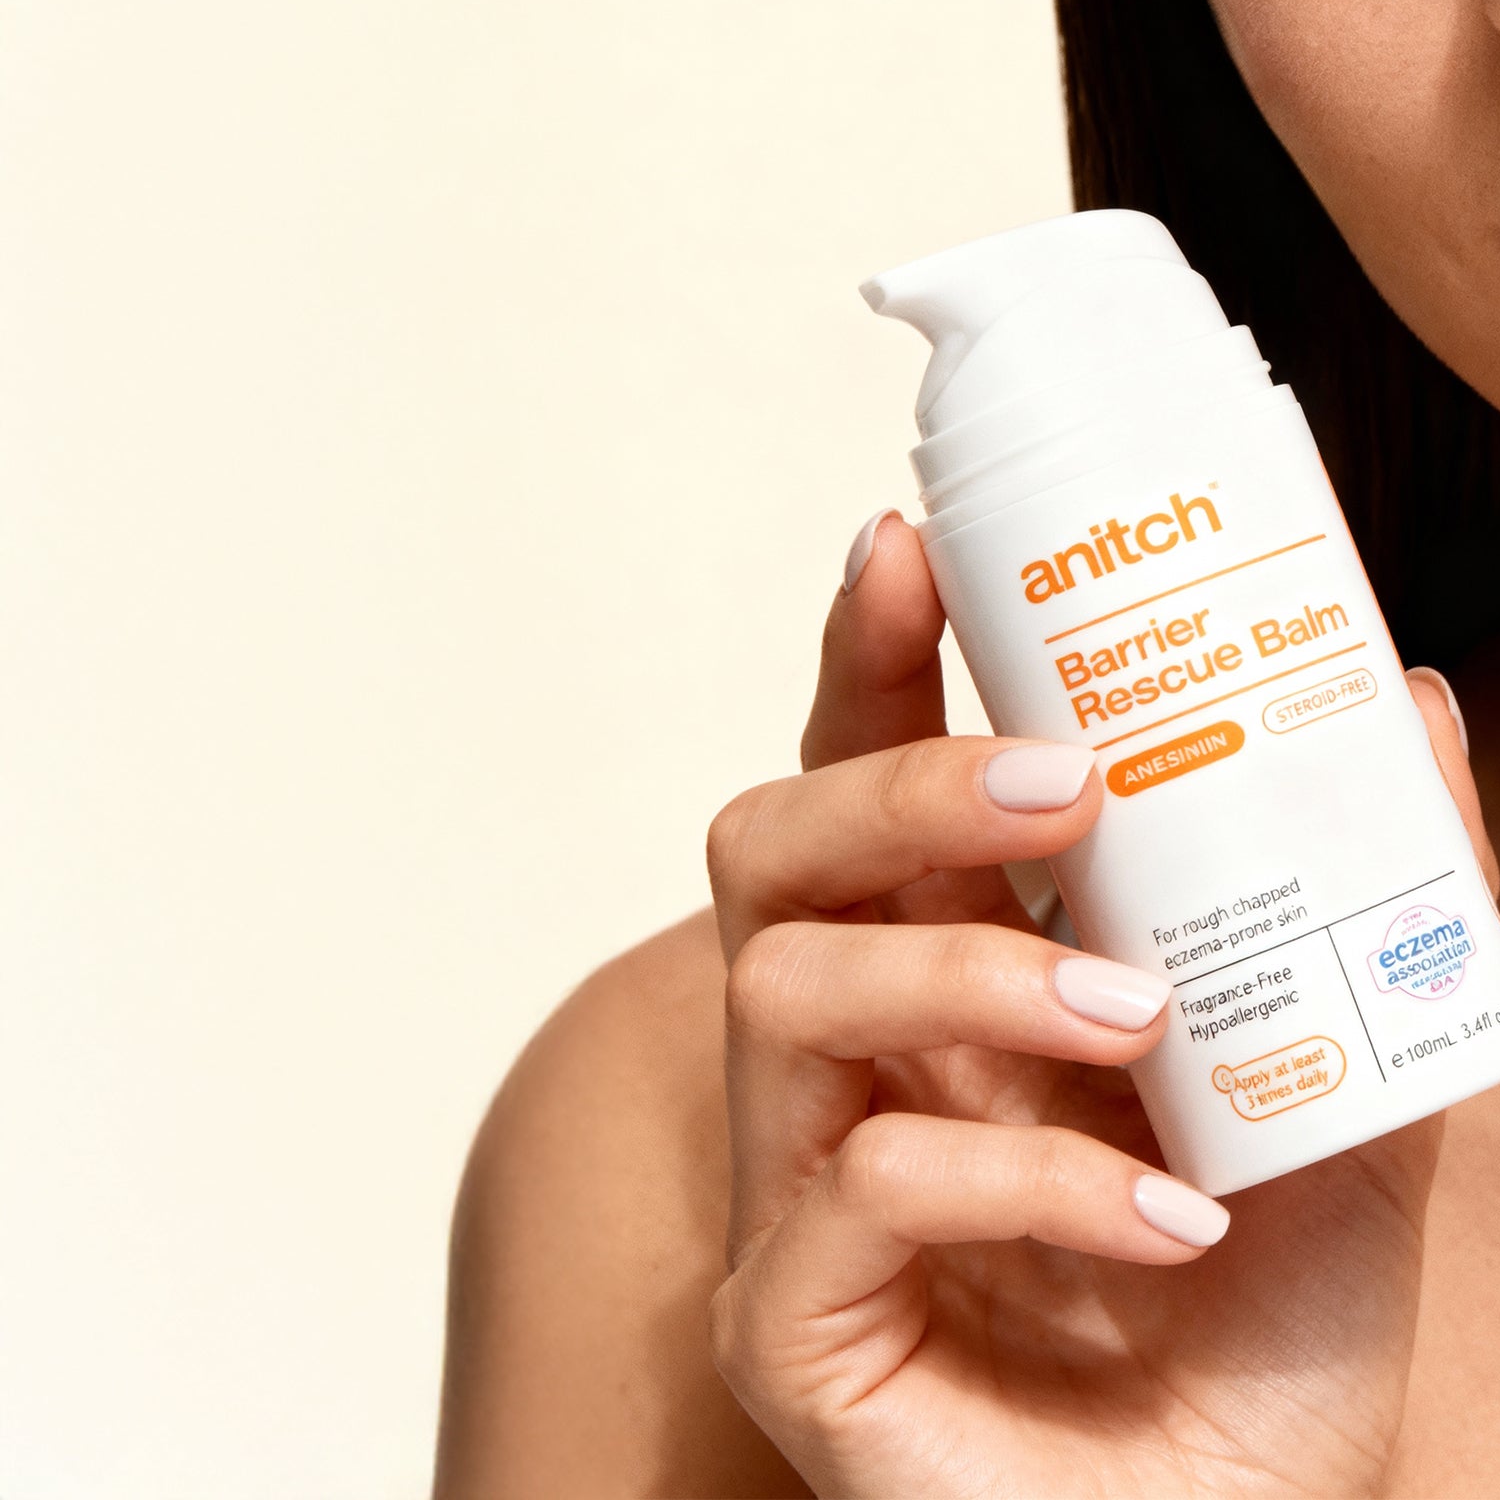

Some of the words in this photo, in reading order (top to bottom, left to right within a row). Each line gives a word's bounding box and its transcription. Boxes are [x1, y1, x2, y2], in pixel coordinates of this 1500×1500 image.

[1021, 493, 1223, 604] anitch
[1055, 609, 1209, 691] Barrier
[1071, 643, 1243, 730] Rescue
[1250, 603, 1349, 658] Balm
[1276, 676, 1371, 724] STEROID-FREE
[1153, 928, 1179, 947] For
[1183, 906, 1230, 937] rough
[1232, 877, 1301, 916] chapped
[1165, 919, 1274, 970] eczema-prone
[1277, 905, 1308, 927] skin
[1379, 919, 1465, 969] eczema
[1180, 967, 1293, 1018] Fragrance-Free
[1189, 989, 1300, 1042] Hypoallergenic
[1406, 1031, 1457, 1062] 100mL
[1460, 1011, 1492, 1039] 3.4fl
[1234, 1069, 1270, 1092] Apply
[1274, 1061, 1289, 1078] at
[1290, 1047, 1326, 1071] least
[1296, 1069, 1328, 1092] daily
